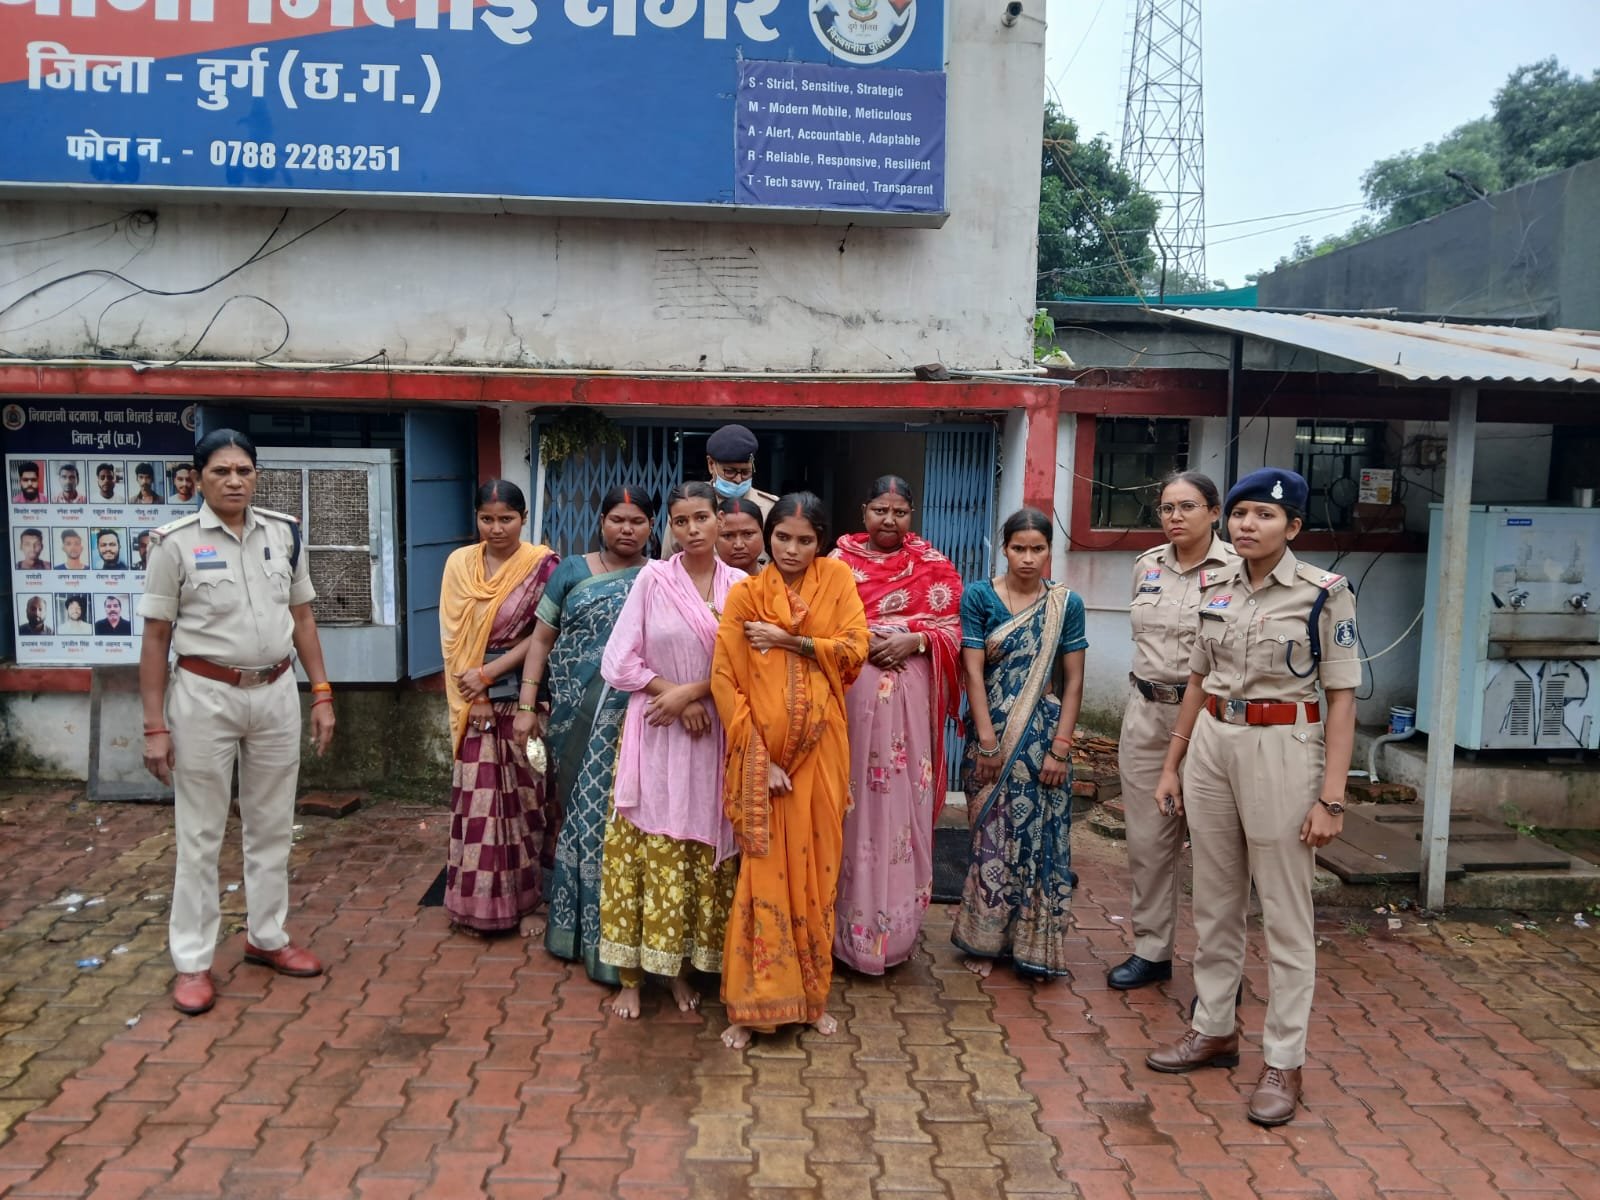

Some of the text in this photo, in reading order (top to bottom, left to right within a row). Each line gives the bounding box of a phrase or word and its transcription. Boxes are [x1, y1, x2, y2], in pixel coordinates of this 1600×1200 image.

[26, 41, 155, 94] जिला
[197, 47, 271, 111] दुर्ग
[748, 77, 756, 88] S
[766, 77, 798, 92] Strict,
[801, 79, 853, 95] Sensitive,
[856, 83, 904, 98] Strategic
[748, 101, 759, 112] M
[769, 102, 809, 115] Modern
[812, 104, 851, 119] Mobile,
[855, 107, 912, 121] Meticulous
[748, 126, 756, 137] A
[765, 126, 794, 140] Alert,
[797, 128, 865, 144] Accountable,
[868, 132, 921, 146] Adaptable
[66, 129, 130, 162] फोन
[136, 137, 171, 164] न.
[210, 140, 276, 169] 0788
[285, 143, 400, 172] 2283251
[747, 150, 756, 161] R
[766, 150, 814, 165] Reliable,
[817, 154, 880, 170] Responsive,
[884, 157, 931, 171] Resilient
[747, 175, 754, 186] T
[764, 175, 788, 187] Tech
[791, 179, 823, 191] savvy,
[827, 178, 869, 193] Trained,
[873, 181, 934, 195] Transparent
[104, 410, 125, 423] थाना
